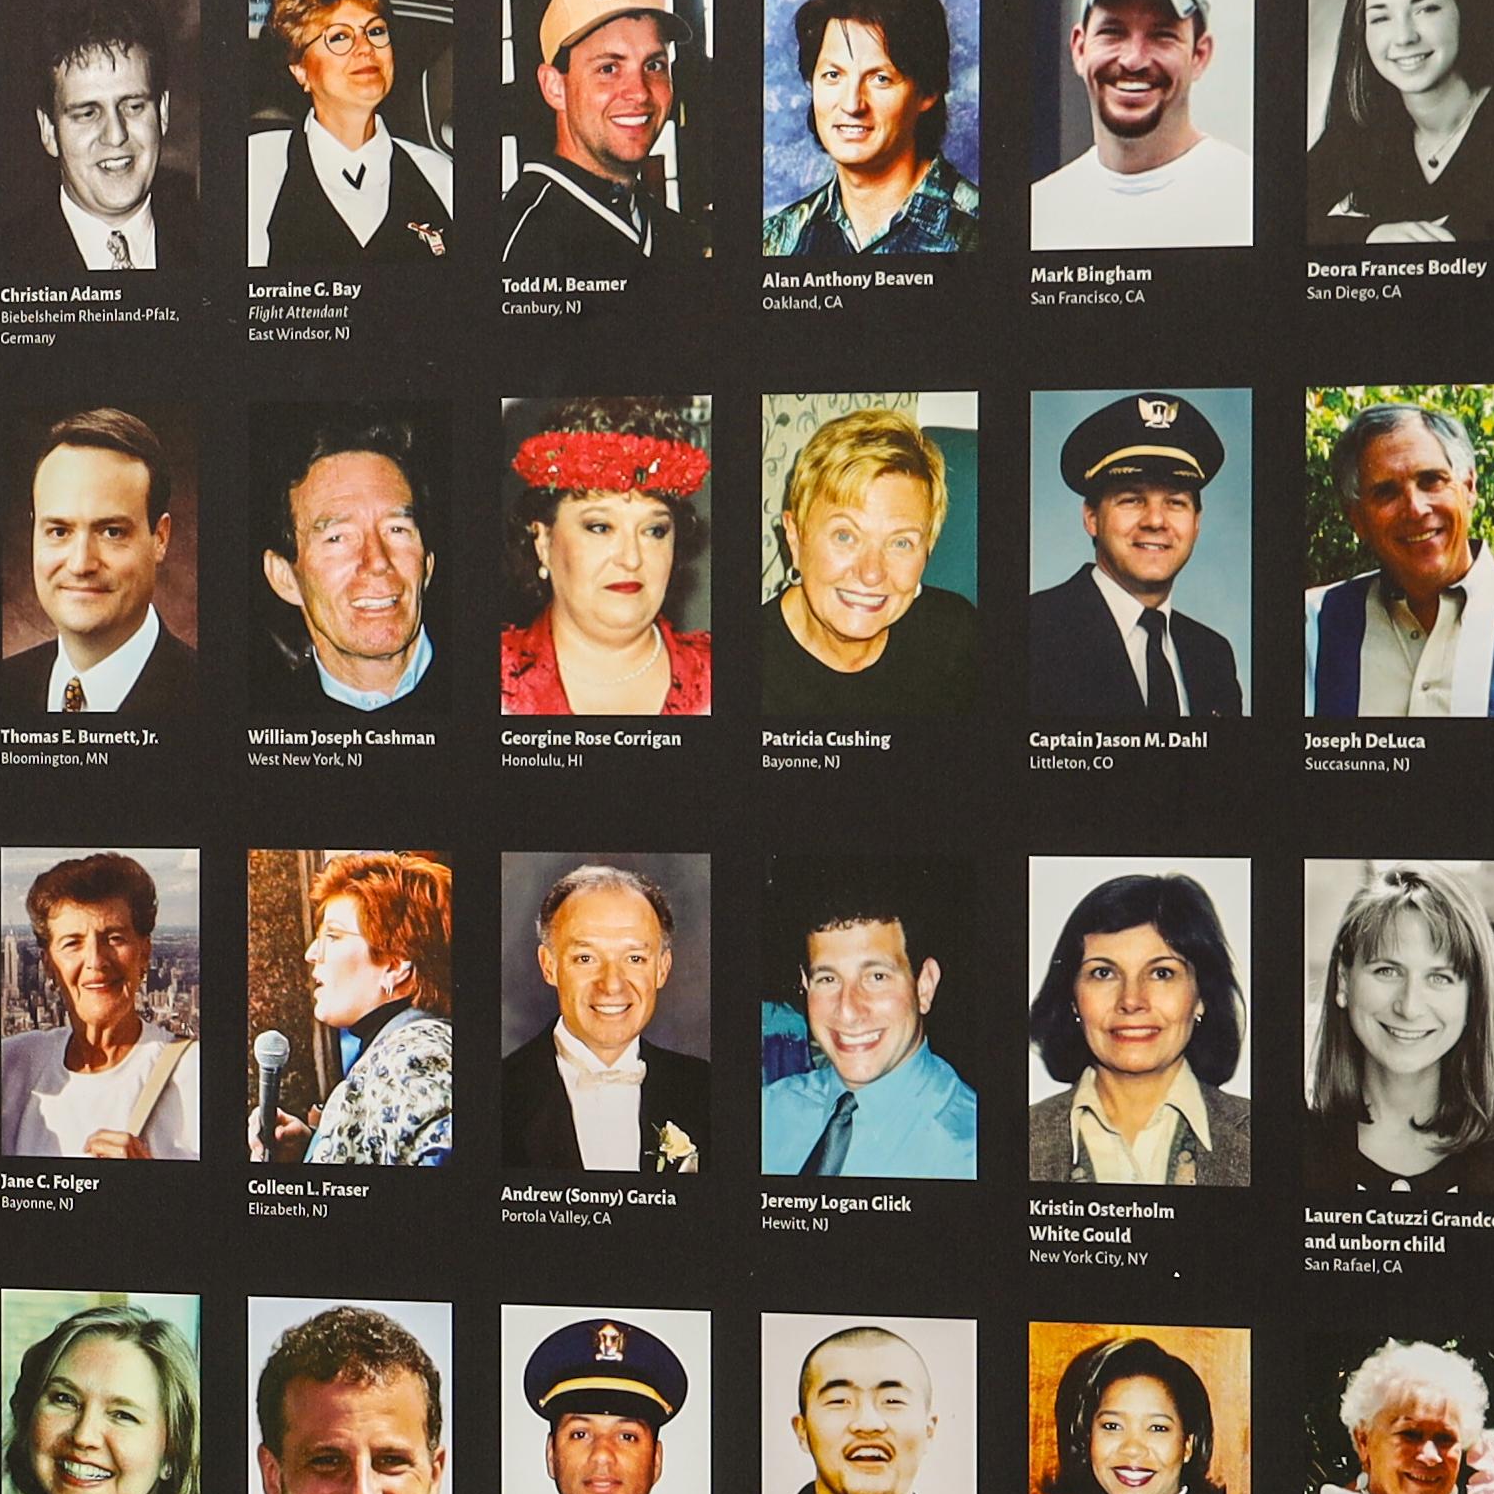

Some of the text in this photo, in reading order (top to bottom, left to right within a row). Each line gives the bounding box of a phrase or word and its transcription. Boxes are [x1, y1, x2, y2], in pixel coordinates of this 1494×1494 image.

[1031, 265, 1151, 285] Mark Bingham
[502, 277, 627, 293] Todd M. Beamer
[1, 286, 122, 302] Christian Adams
[1031, 290, 1145, 304] San Francisco, CA
[502, 300, 581, 316] Cranbury, NJ
[763, 295, 843, 310] Oakland, CA
[2, 307, 179, 323] Biebelsheim Rheinland-Pfalz,
[1, 332, 55, 346] Germany
[248, 729, 435, 748] William Joseph Cashman
[762, 730, 891, 750] Patricia Cushing
[1305, 732, 1425, 752] Joseph DeLuca
[248, 753, 362, 767] West New York, NJ
[763, 755, 840, 770] Bayonne, NJ
[1305, 757, 1409, 772] Succasunna, NJ
[1, 1174, 99, 1193] Jane C. Folger
[2, 1196, 73, 1211] Bayonne, NJ
[501, 1186, 676, 1207] Andrew (Sonny) Garcia
[1030, 1199, 1174, 1219] Kristin Osterholm
[502, 1209, 611, 1227] Portola Valley, CA
[1029, 1225, 1131, 1243] White Gould
[1030, 1249, 1149, 1267] New York City, NY
